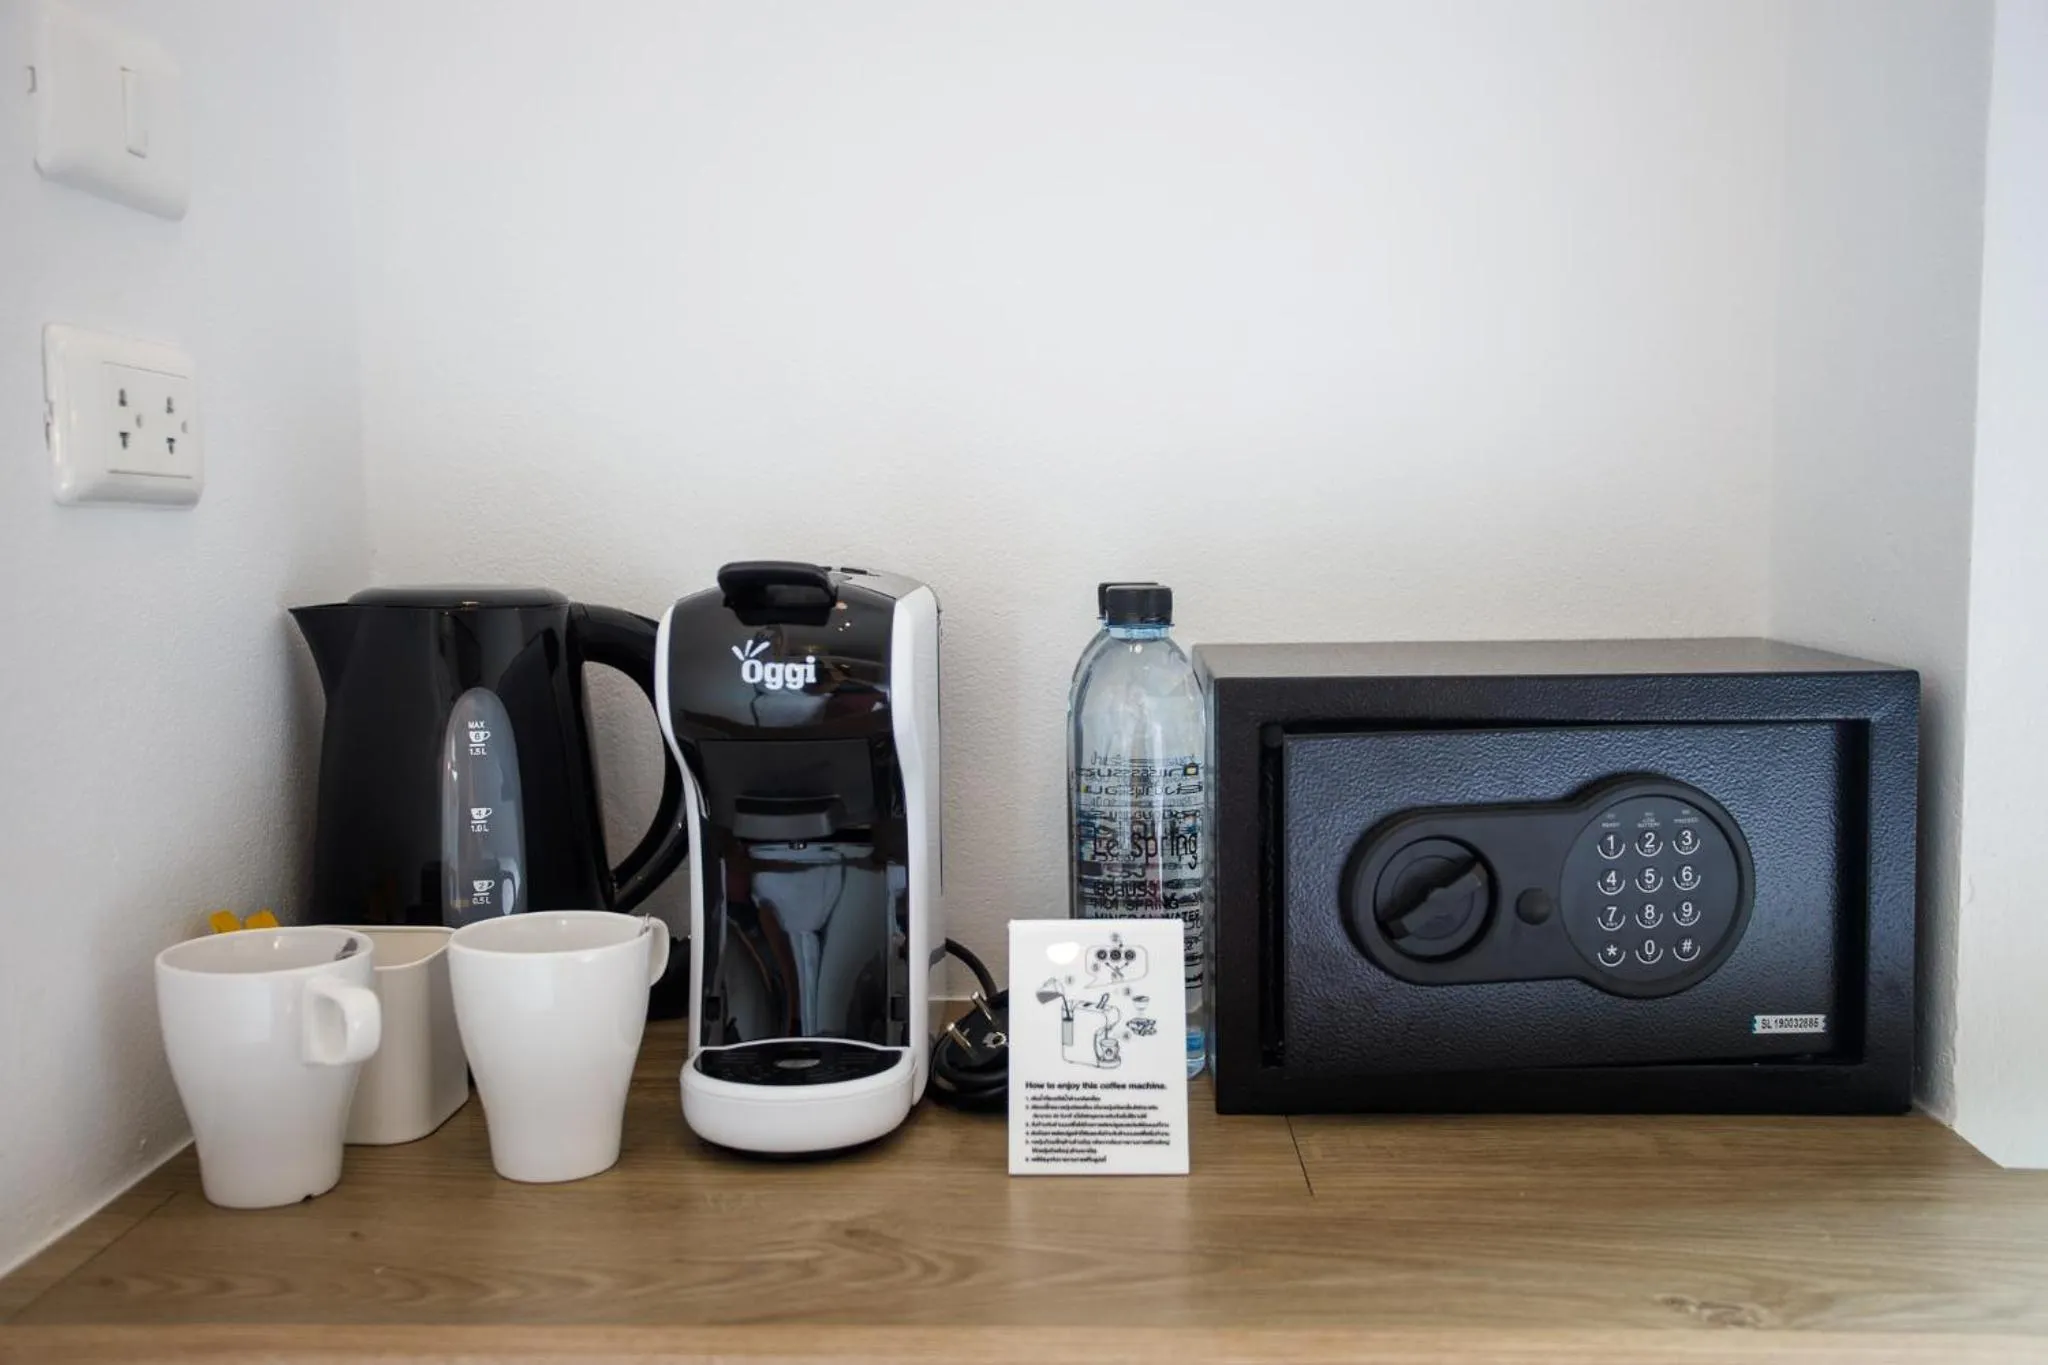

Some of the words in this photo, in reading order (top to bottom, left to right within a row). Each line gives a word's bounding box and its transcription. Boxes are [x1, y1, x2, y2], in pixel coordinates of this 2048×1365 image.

[741, 655, 817, 690] Oggi
[467, 720, 485, 729] MAX
[1606, 834, 1615, 850] 1
[1644, 832, 1656, 848] 2
[1681, 830, 1693, 846] 3
[1606, 870, 1617, 886] 4
[1644, 868, 1656, 884] 5
[1681, 866, 1693, 882] 6
[1606, 906, 1617, 922] 7
[1644, 904, 1655, 920] 8
[1681, 901, 1693, 917] 9
[1644, 939, 1655, 955] 0
[1057, 1082, 1080, 1090] enjoy
[1082, 1081, 1098, 1089] this
[1100, 1081, 1127, 1089] coffee
[1128, 1081, 1167, 1089] machine.
